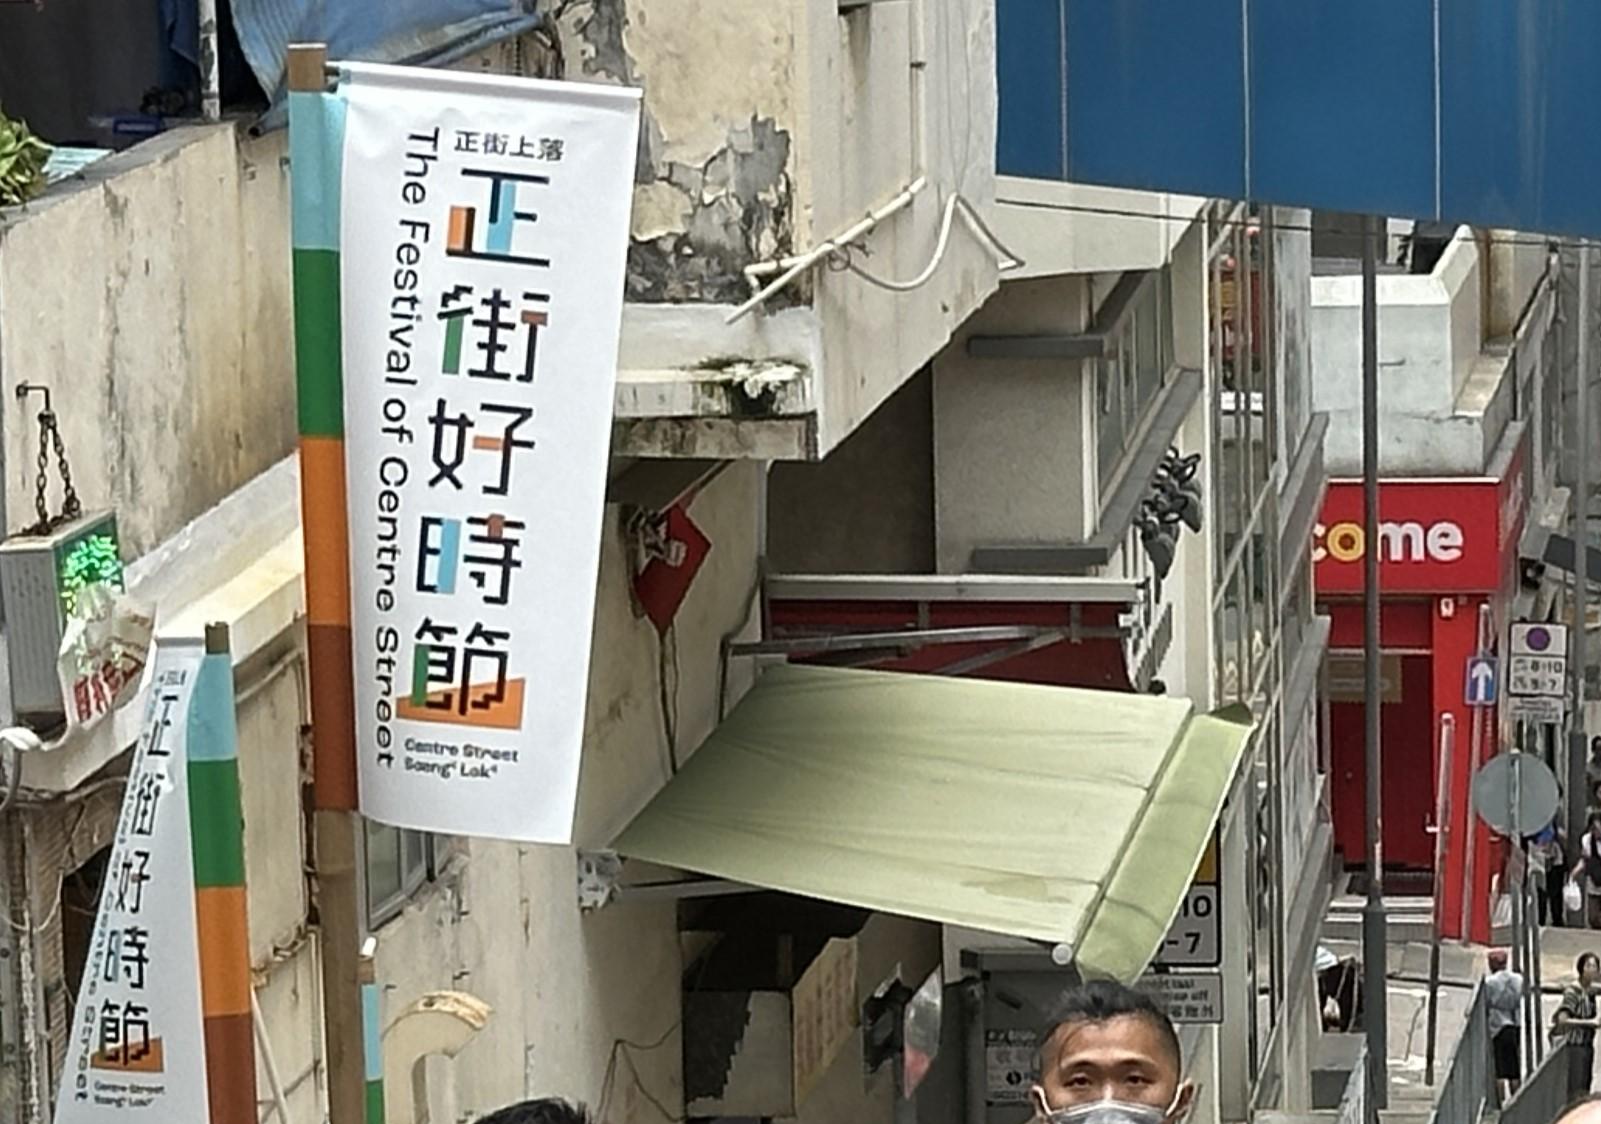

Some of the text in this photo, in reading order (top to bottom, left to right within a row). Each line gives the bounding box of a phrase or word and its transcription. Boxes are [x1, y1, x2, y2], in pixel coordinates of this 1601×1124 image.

[455, 130, 563, 161] 正街上落
[376, 127, 439, 768] The Festival of Centre Street
[410, 167, 551, 716] 正街好時節
